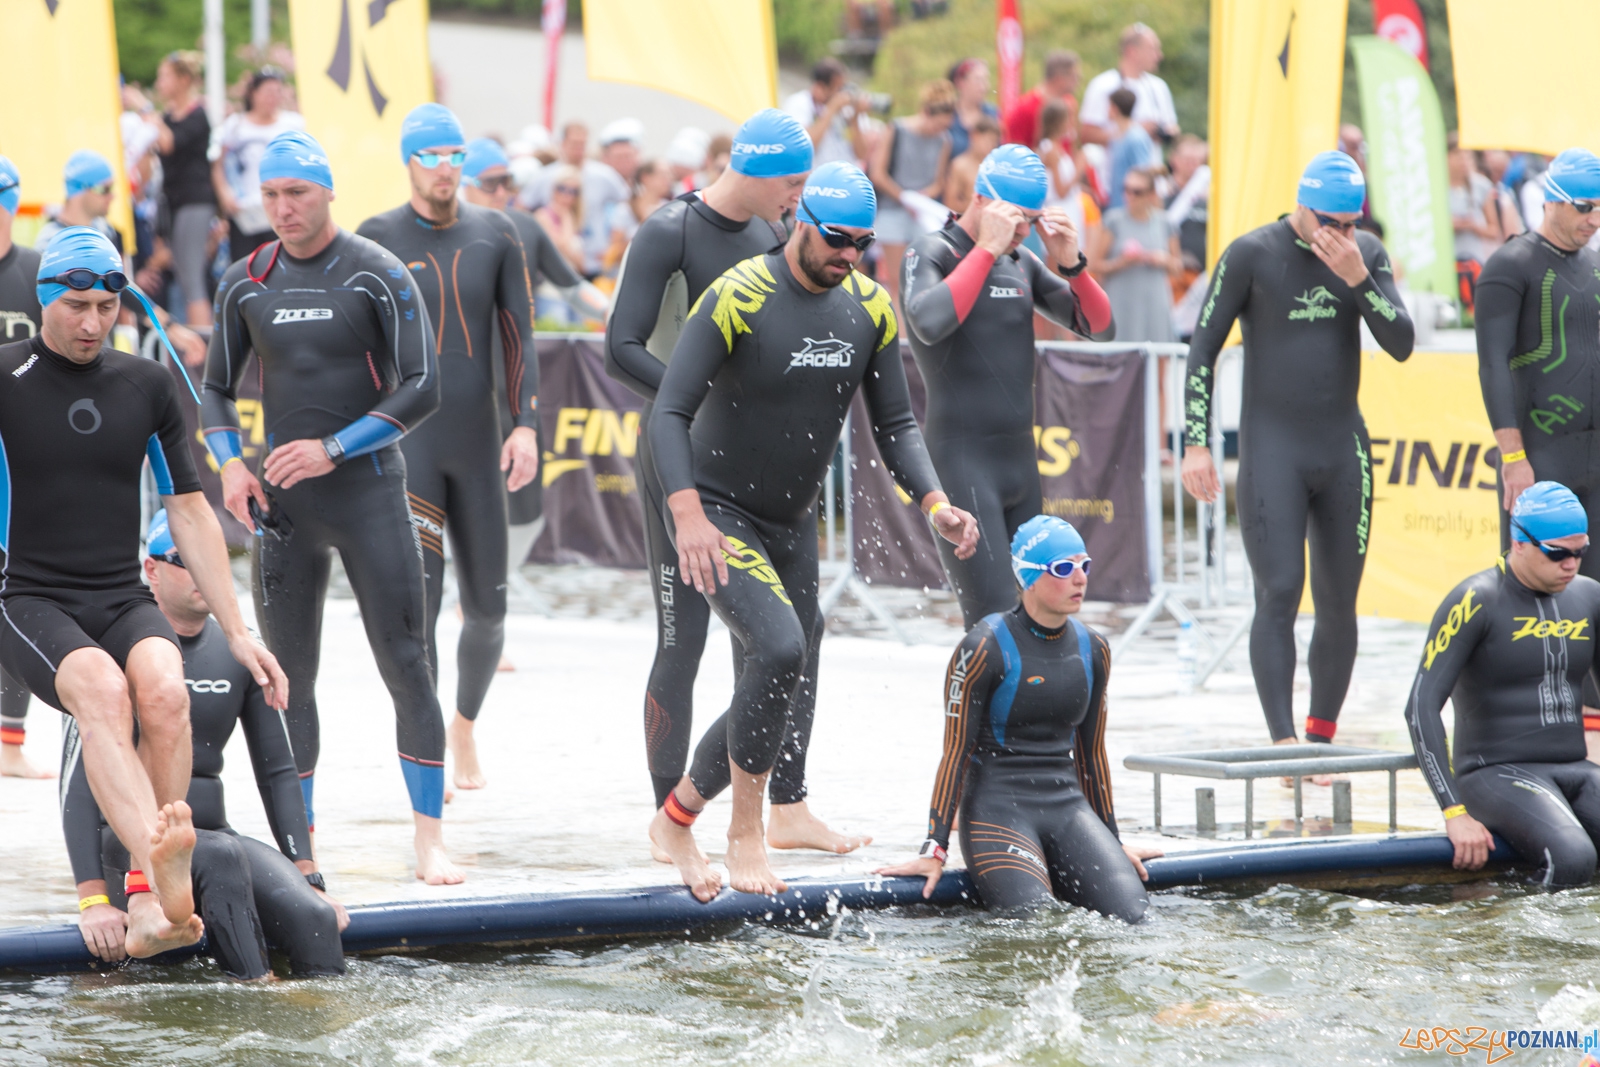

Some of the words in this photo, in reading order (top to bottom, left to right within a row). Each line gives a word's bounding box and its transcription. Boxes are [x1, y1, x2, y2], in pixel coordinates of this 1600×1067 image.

[734, 143, 785, 155] FINIS
[1288, 306, 1338, 323] sailfish
[12, 353, 39, 378] TRIBORD
[790, 352, 852, 368] ZAOSU
[553, 407, 640, 457] FIN
[1353, 431, 1371, 555] vibrant
[1042, 496, 1114, 524] wimming
[720, 533, 793, 606] AOSU
[184, 679, 232, 694] rca
[945, 647, 973, 718] helix
